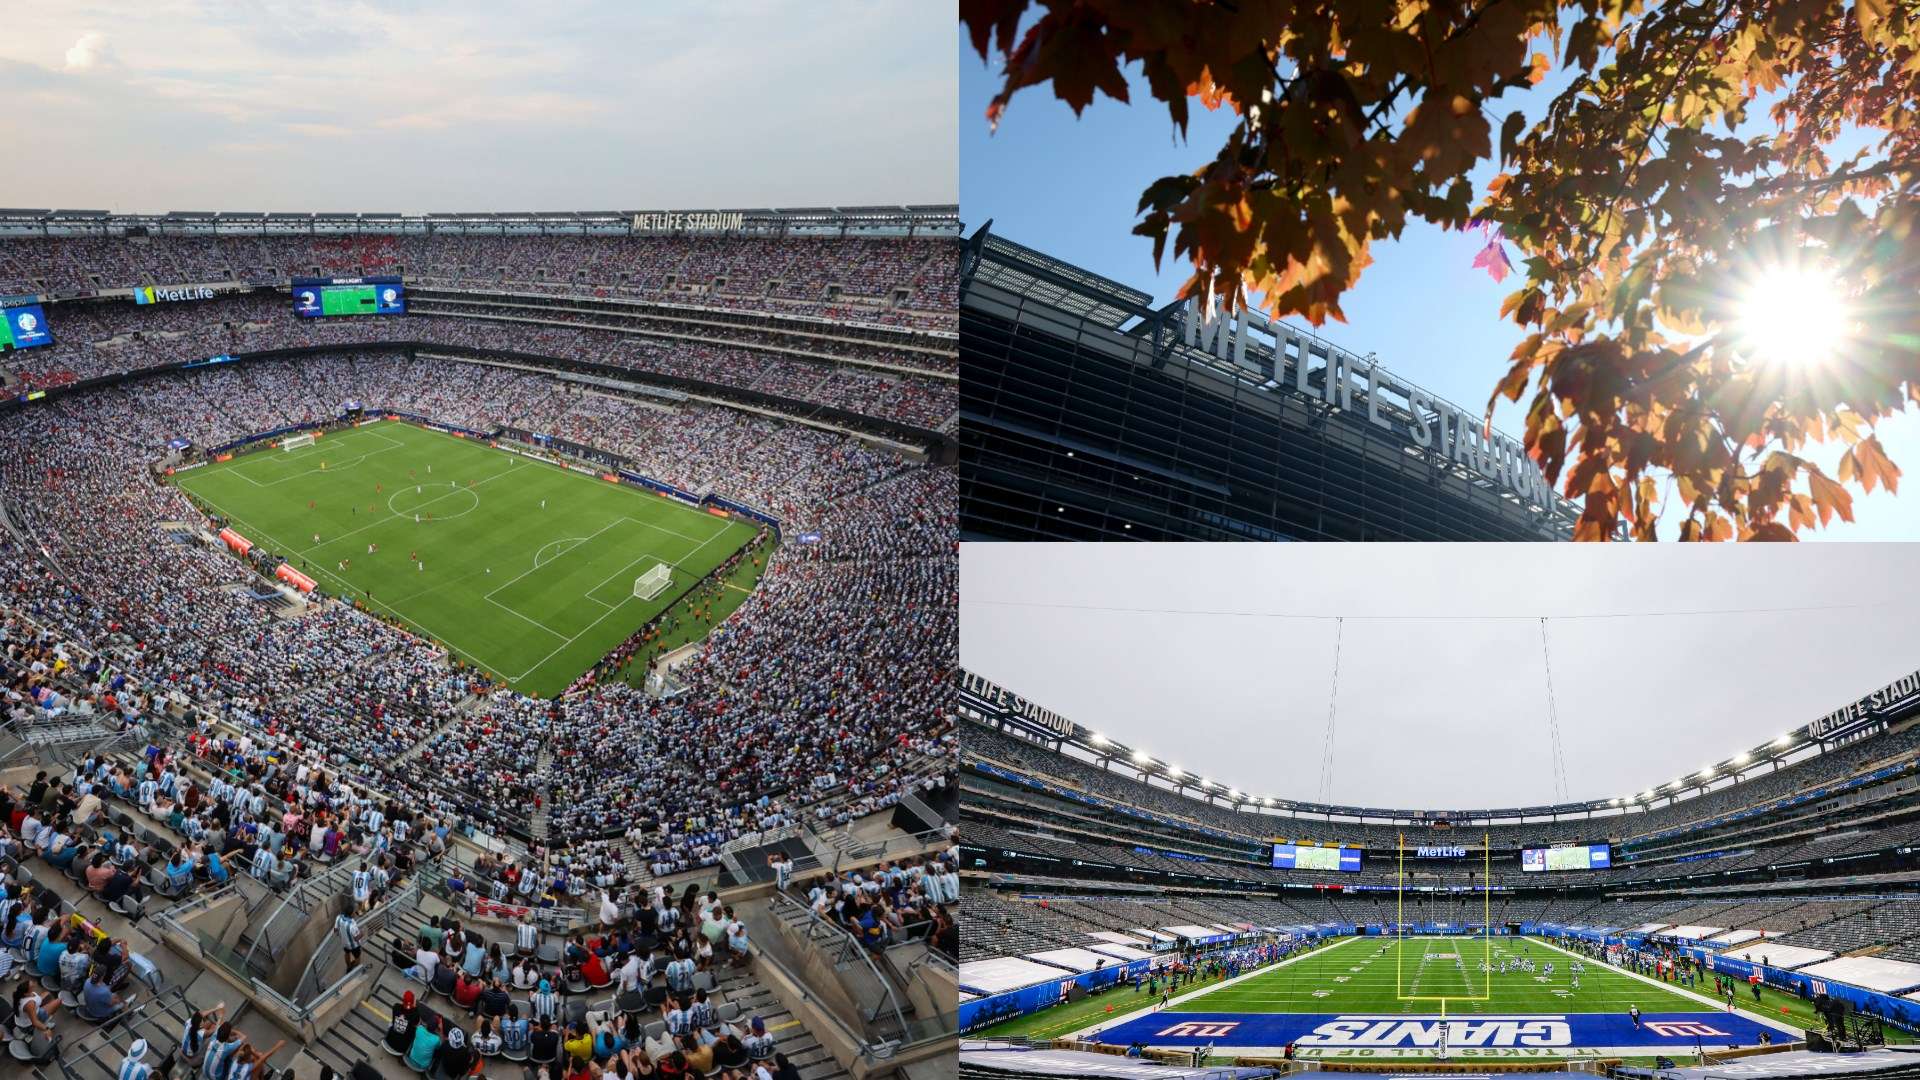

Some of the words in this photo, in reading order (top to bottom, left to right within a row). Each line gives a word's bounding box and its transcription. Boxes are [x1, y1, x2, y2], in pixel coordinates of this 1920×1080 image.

[634, 214, 683, 230] METLIFE
[685, 213, 743, 230] STADIUM
[155, 286, 214, 302] MetLife
[1184, 294, 1392, 431] METLIFE
[1012, 694, 1074, 737] STADIUM
[1808, 699, 1868, 738] METLIFE
[1417, 846, 1466, 857] MetLife
[1550, 841, 1576, 850] verizon
[355, 876, 364, 889] 10
[678, 971, 689, 981] 21
[504, 1029, 520, 1042] 10
[1293, 1021, 1572, 1047] GIANTS
[1336, 1048, 1376, 1057] OF
[1393, 1048, 1442, 1057] ALL
[1462, 1048, 1560, 1057] TAKES
